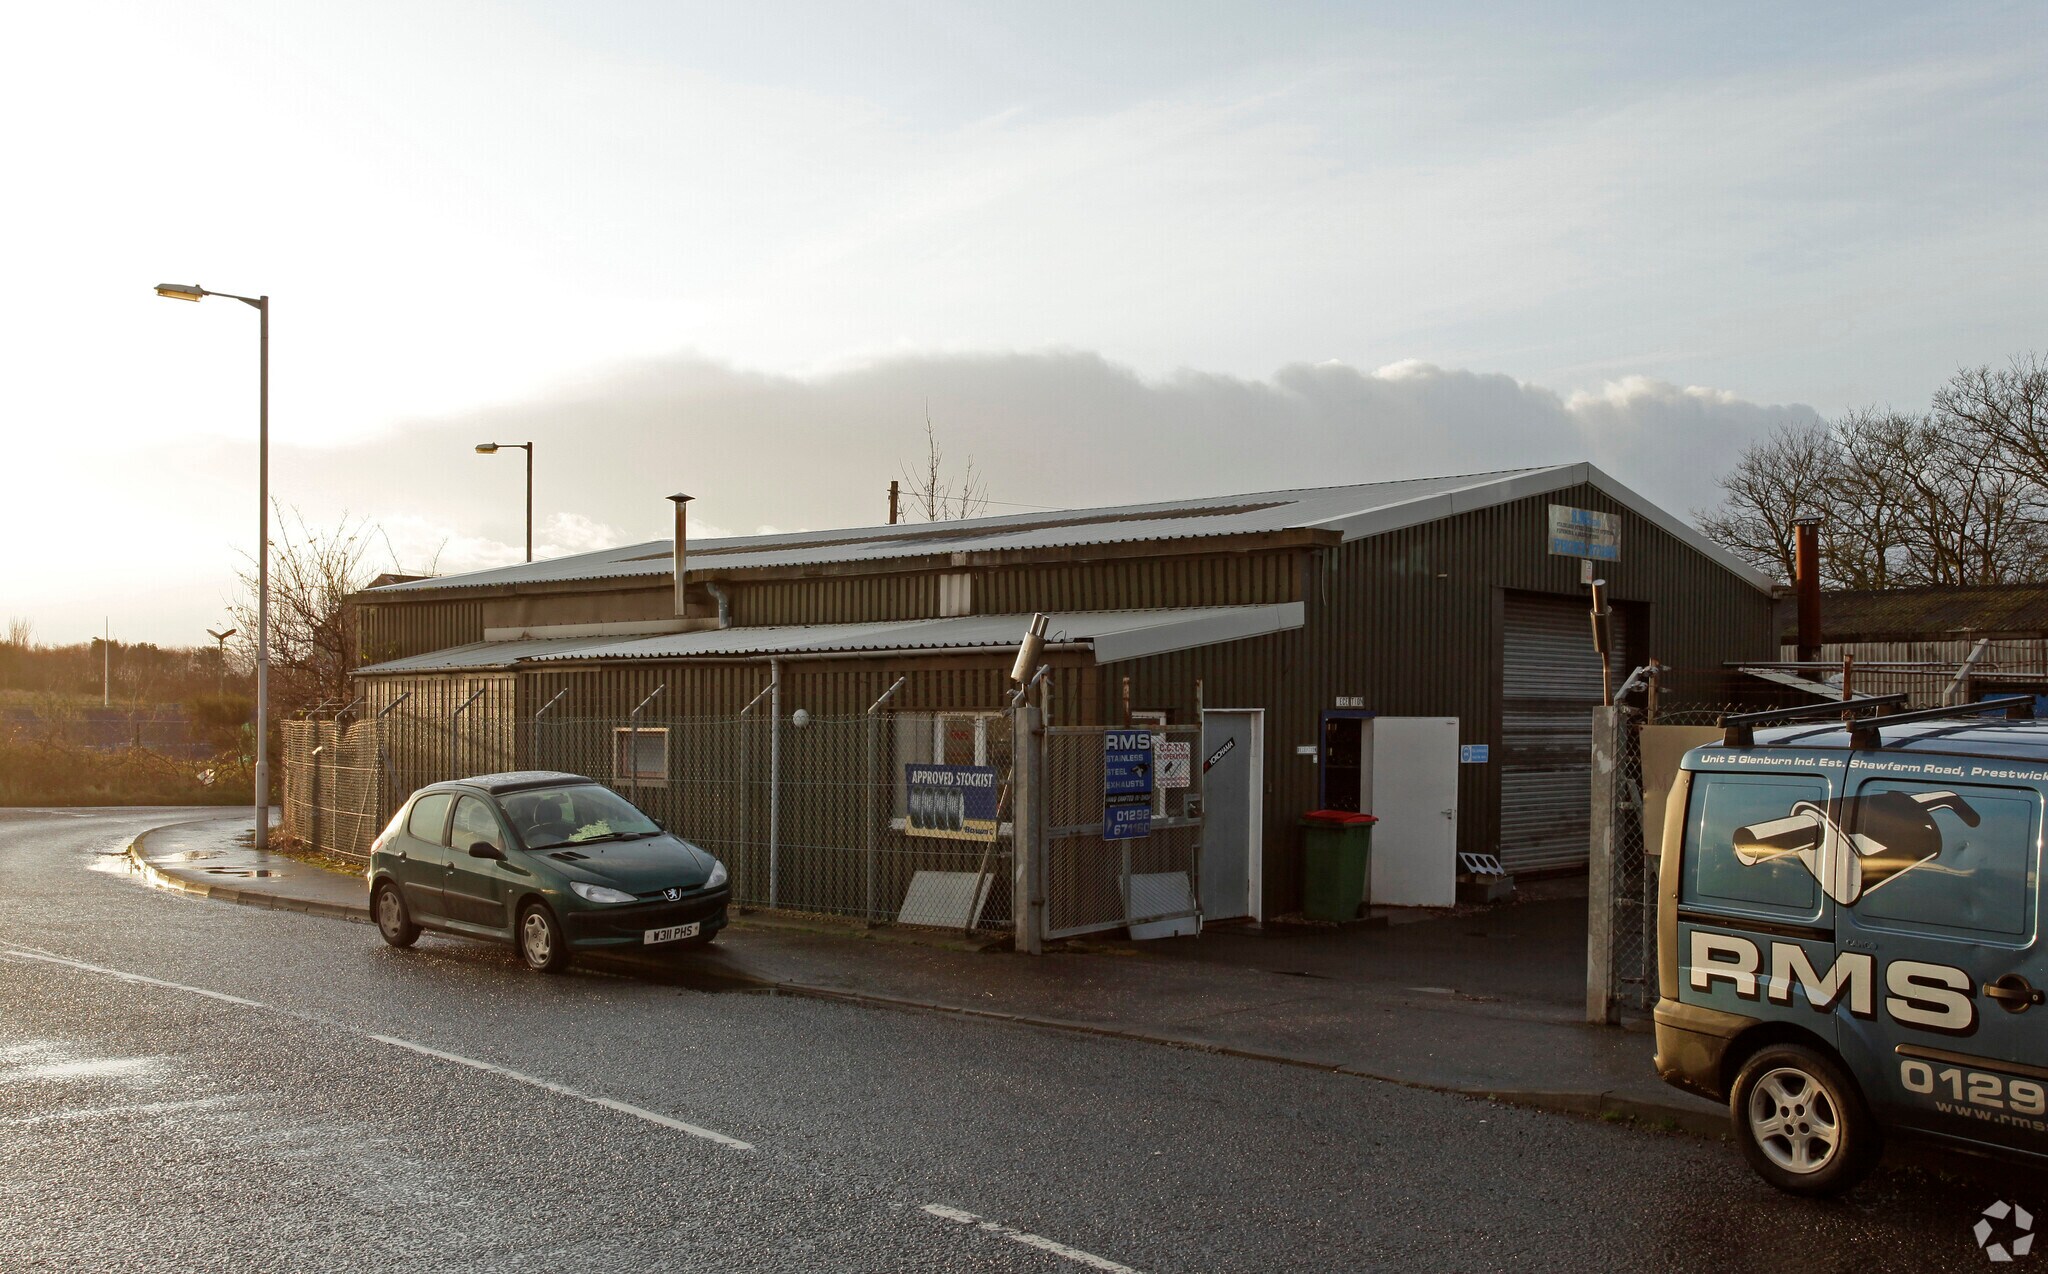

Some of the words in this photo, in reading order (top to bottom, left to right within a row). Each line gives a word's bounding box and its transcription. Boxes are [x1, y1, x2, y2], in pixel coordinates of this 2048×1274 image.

[1105, 733, 1151, 750] RMS
[1106, 754, 1144, 763] STAINLESS
[1209, 740, 1234, 765] YOKOHAMA
[1106, 768, 1127, 776] STEEL
[1701, 755, 1726, 765] Unit
[1727, 755, 1736, 764] 5
[1738, 755, 1792, 767] Glenburn
[1793, 757, 1816, 767] Ind.
[1818, 758, 1845, 768] Est.
[1849, 760, 1921, 773] Shawfarm
[1923, 764, 1965, 777] Road,
[911, 770, 954, 786] APPROVED
[956, 772, 994, 787] STOCKIST
[1106, 779, 1145, 789] EXHAUSTS
[1116, 808, 1150, 821] 01292
[653, 929, 672, 941] W311
[673, 925, 692, 939] PHS
[1689, 930, 1977, 1035] RMS
[1900, 1059, 2046, 1115] 0129
[1935, 1101, 2048, 1133] www.rms
